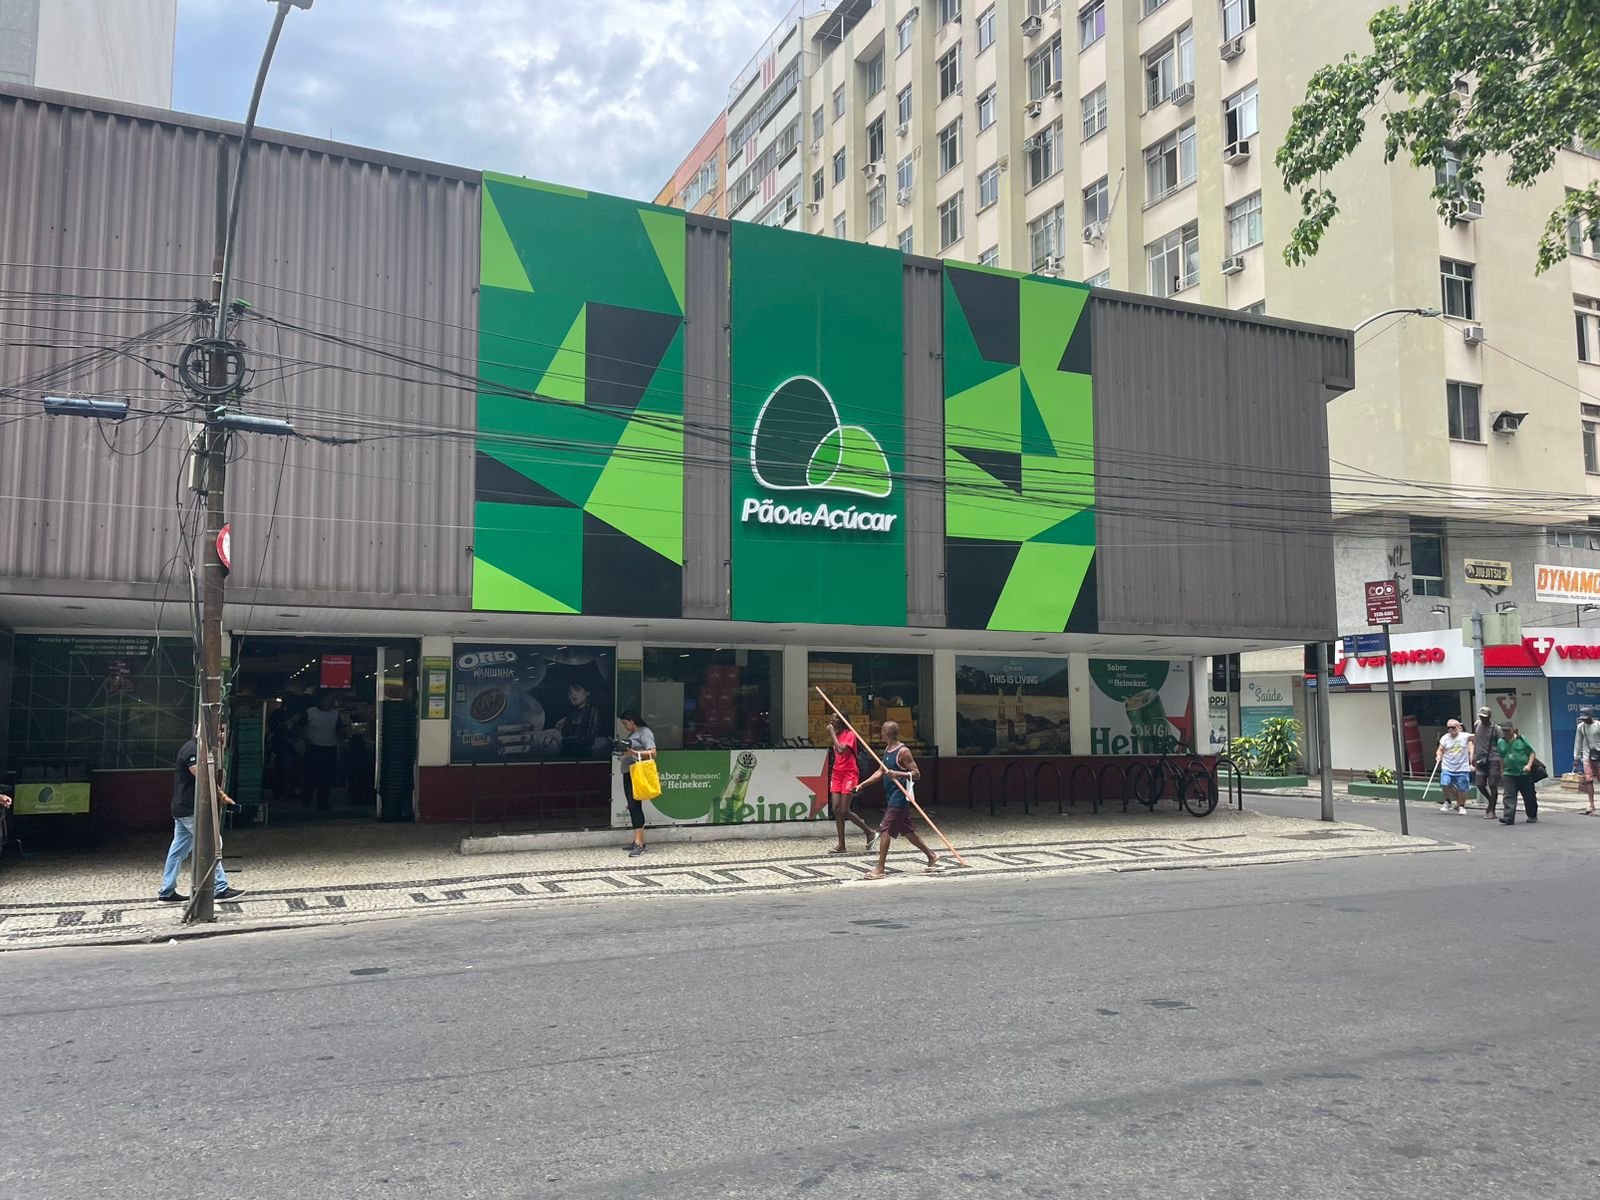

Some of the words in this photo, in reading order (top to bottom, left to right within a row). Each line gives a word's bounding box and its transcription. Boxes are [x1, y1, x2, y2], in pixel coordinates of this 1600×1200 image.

[456, 651, 516, 671] OREO
[1106, 663, 1128, 671] Sabor
[989, 674, 1006, 684] THIS
[1007, 675, 1014, 684] IS
[1015, 674, 1039, 684] LIVING
[1255, 688, 1283, 703] Saúde
